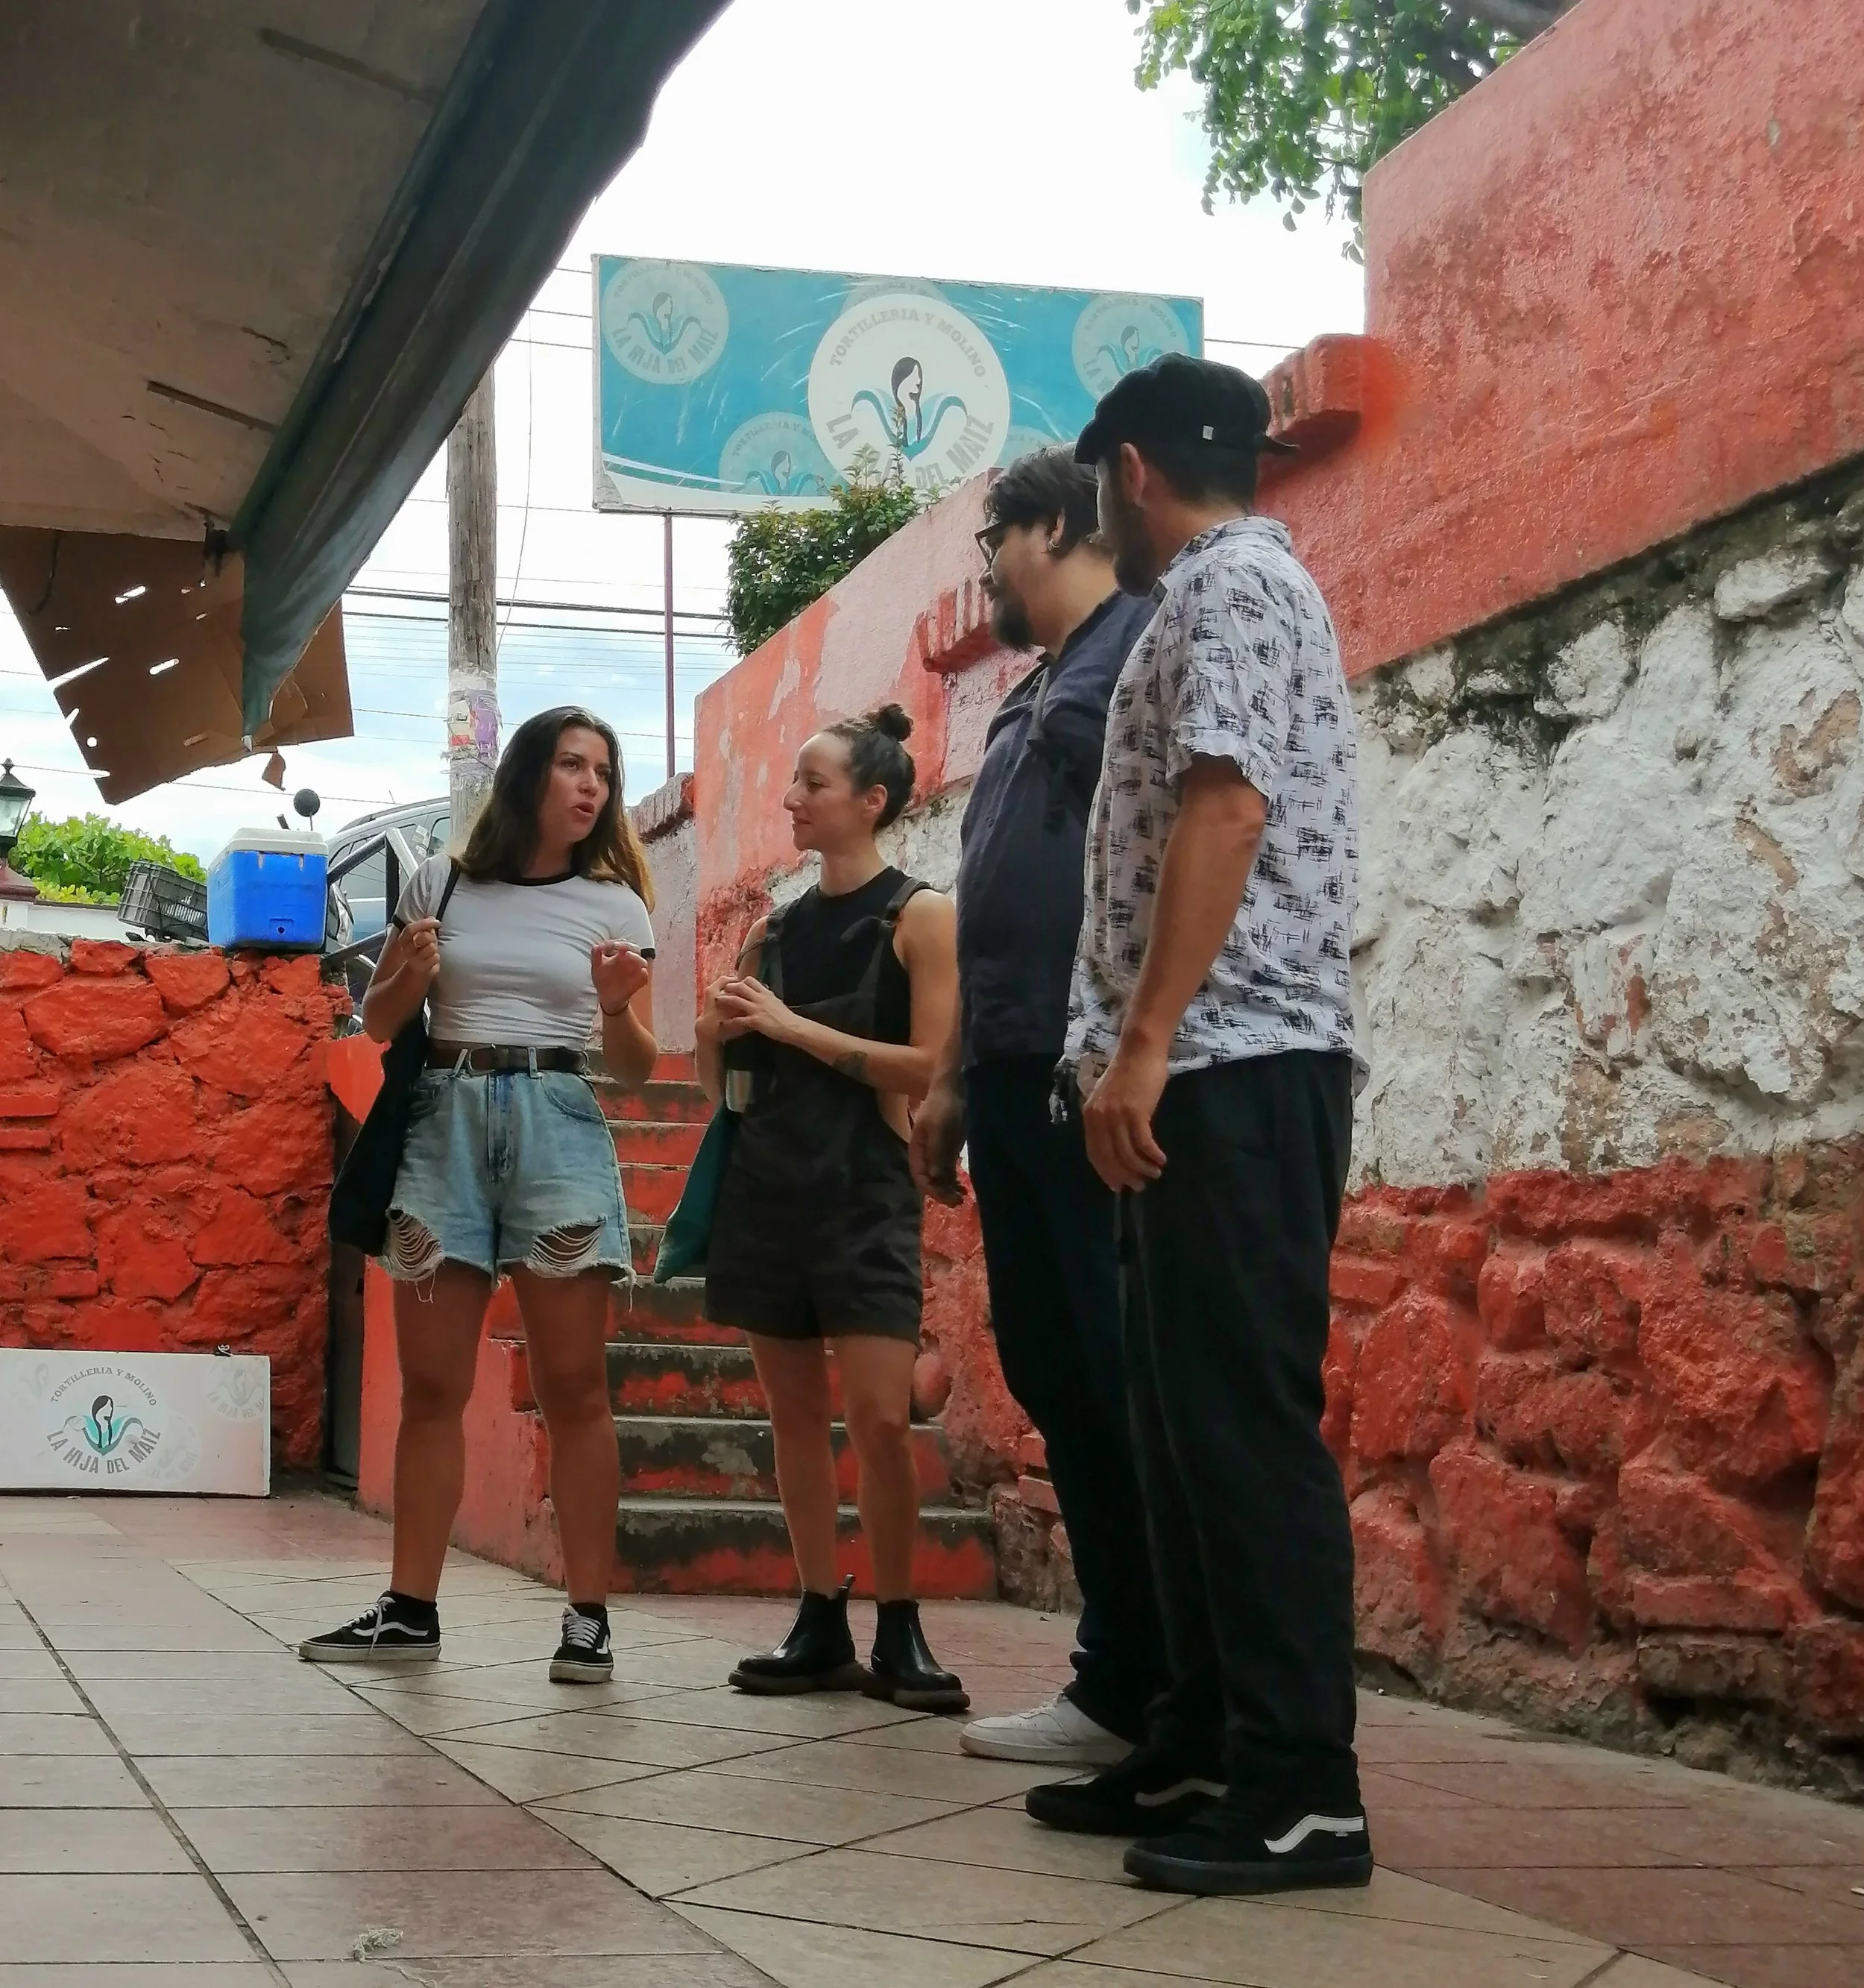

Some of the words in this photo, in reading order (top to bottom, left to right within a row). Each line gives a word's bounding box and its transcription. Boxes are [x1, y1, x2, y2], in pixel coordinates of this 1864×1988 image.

[829, 308, 919, 366] TORTILLERIA
[925, 312, 936, 325] Y
[936, 319, 986, 377] MOLINO
[826, 413, 859, 449] LA
[915, 462, 949, 490] DEL
[945, 415, 994, 474] MAIZ
[50, 1366, 113, 1403] TORTILLERIA
[116, 1368, 124, 1377] Y
[125, 1372, 157, 1406] MOLINO
[46, 1429, 69, 1451] LA
[63, 1447, 99, 1474] HIJA
[107, 1457, 130, 1474] DEL
[127, 1427, 161, 1464] MAIZ
